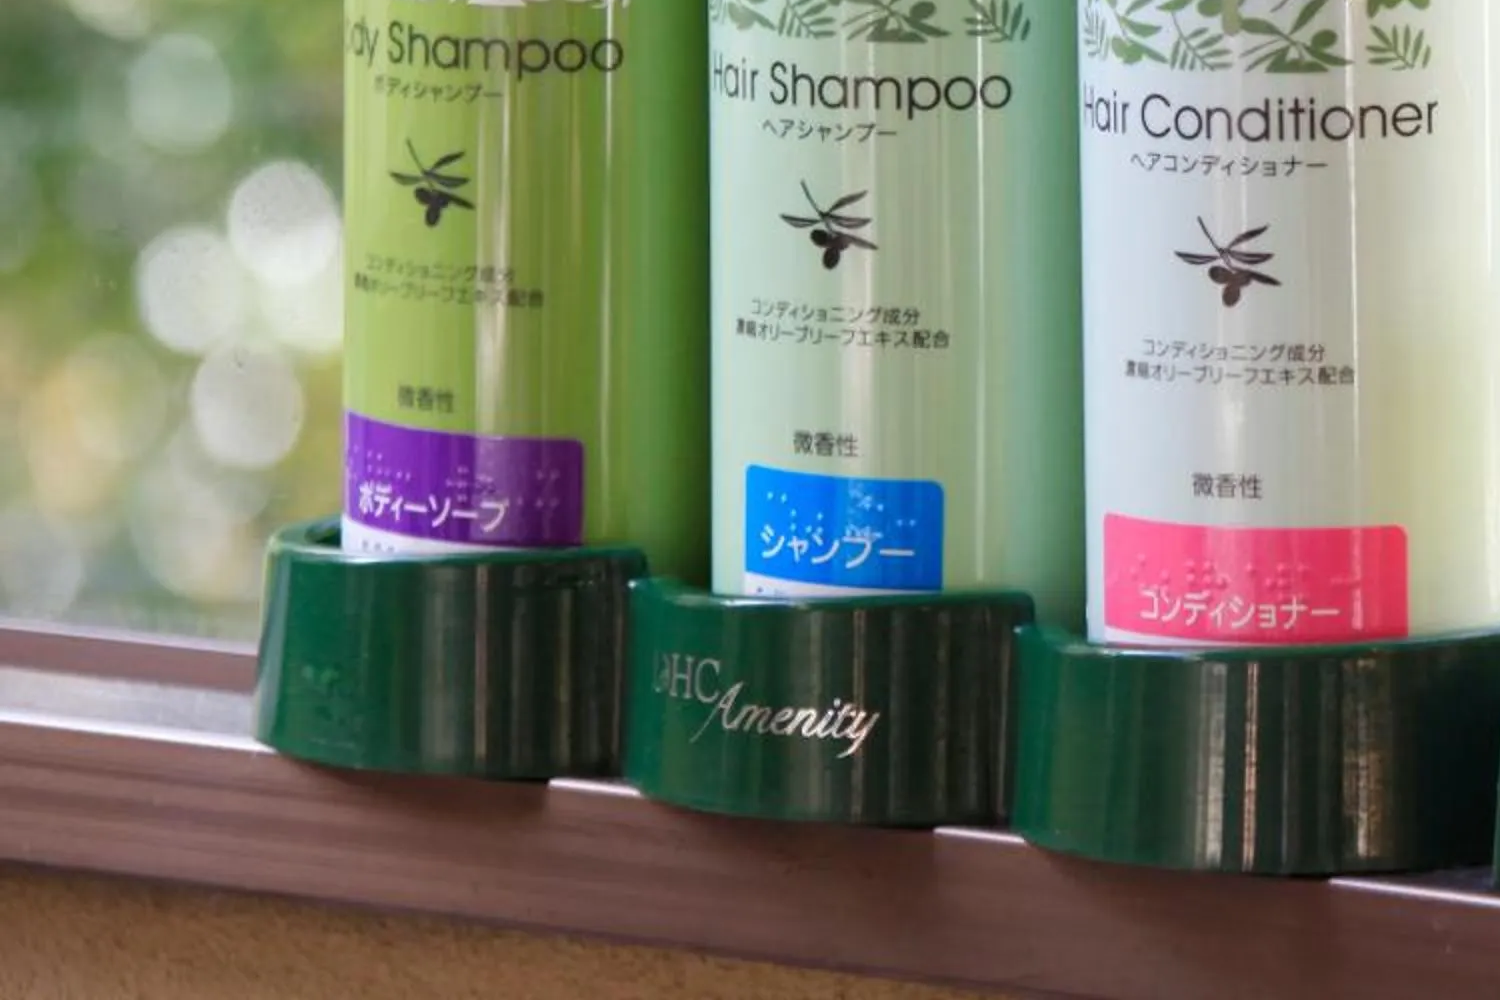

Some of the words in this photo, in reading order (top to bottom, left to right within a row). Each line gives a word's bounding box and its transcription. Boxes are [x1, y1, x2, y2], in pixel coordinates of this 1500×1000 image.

[388, 20, 624, 81] Shampoo
[713, 53, 759, 101] Hair
[769, 60, 1012, 120] Shampoo
[1083, 81, 1130, 135] Hair
[1140, 92, 1438, 143] Conditioner
[762, 118, 898, 143] ヘアシャンプー
[1131, 152, 1328, 177] ヘアコンディショナー
[1192, 473, 1264, 499] 微香性
[1138, 587, 1340, 631] コンディショナー
[690, 681, 880, 759] Amenity
